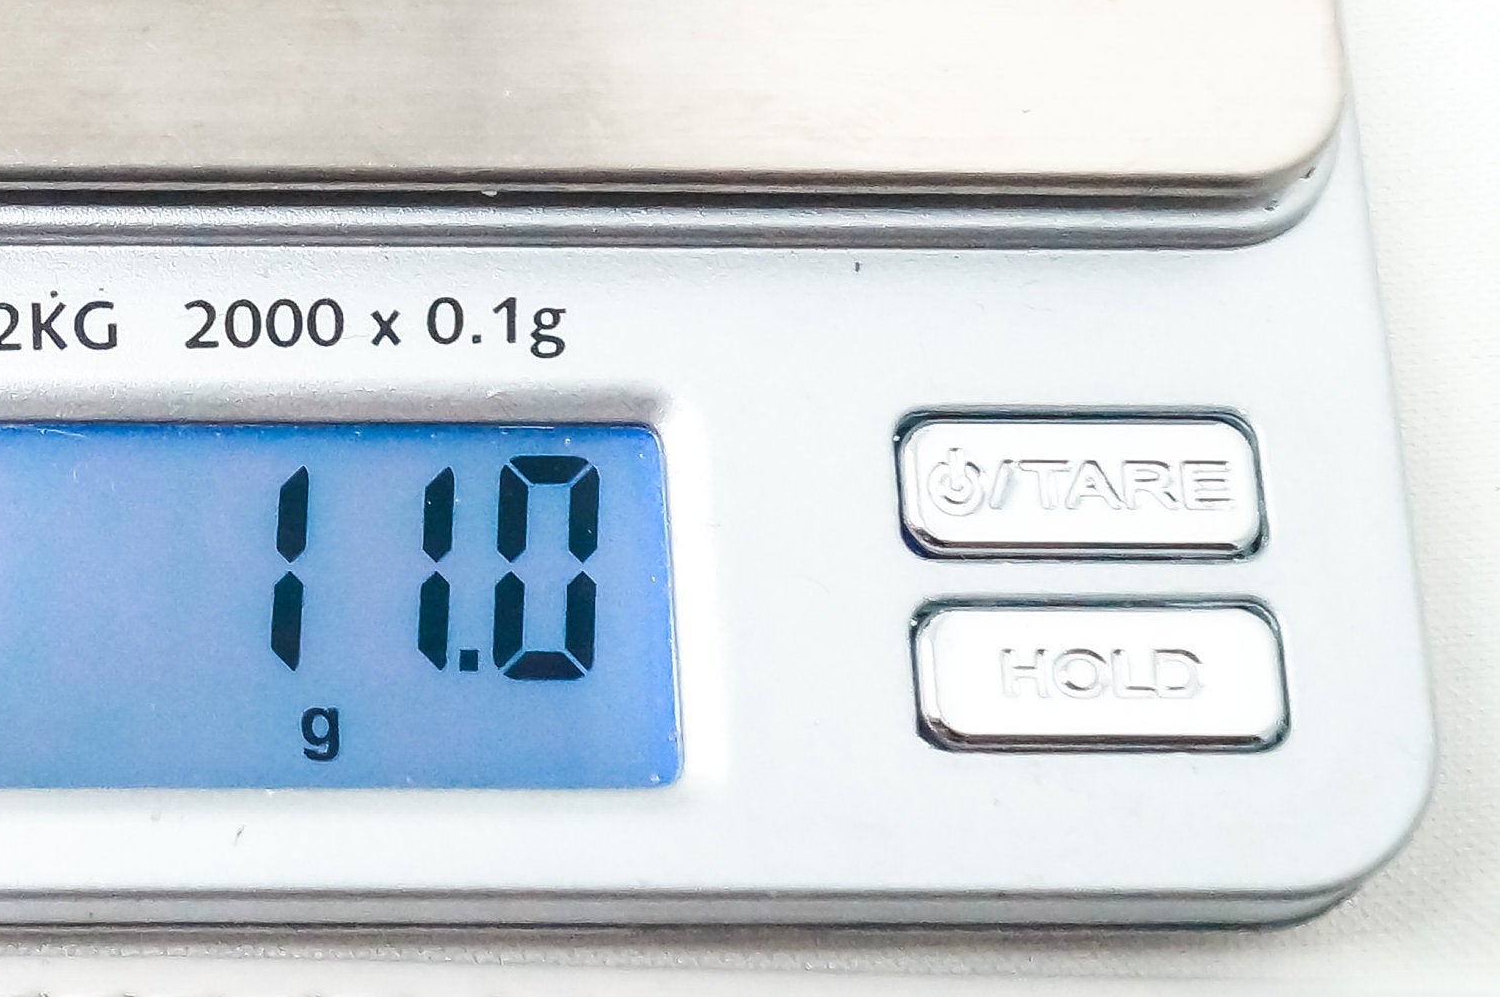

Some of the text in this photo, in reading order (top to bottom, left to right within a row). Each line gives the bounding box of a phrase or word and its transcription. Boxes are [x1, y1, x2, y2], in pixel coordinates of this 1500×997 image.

[184, 298, 345, 349] 2000
[371, 309, 400, 347] x
[426, 296, 567, 359] 0.1g
[271, 454, 599, 681] 11.0
[1000, 647, 1203, 698] HOLD
[301, 705, 341, 761] g
